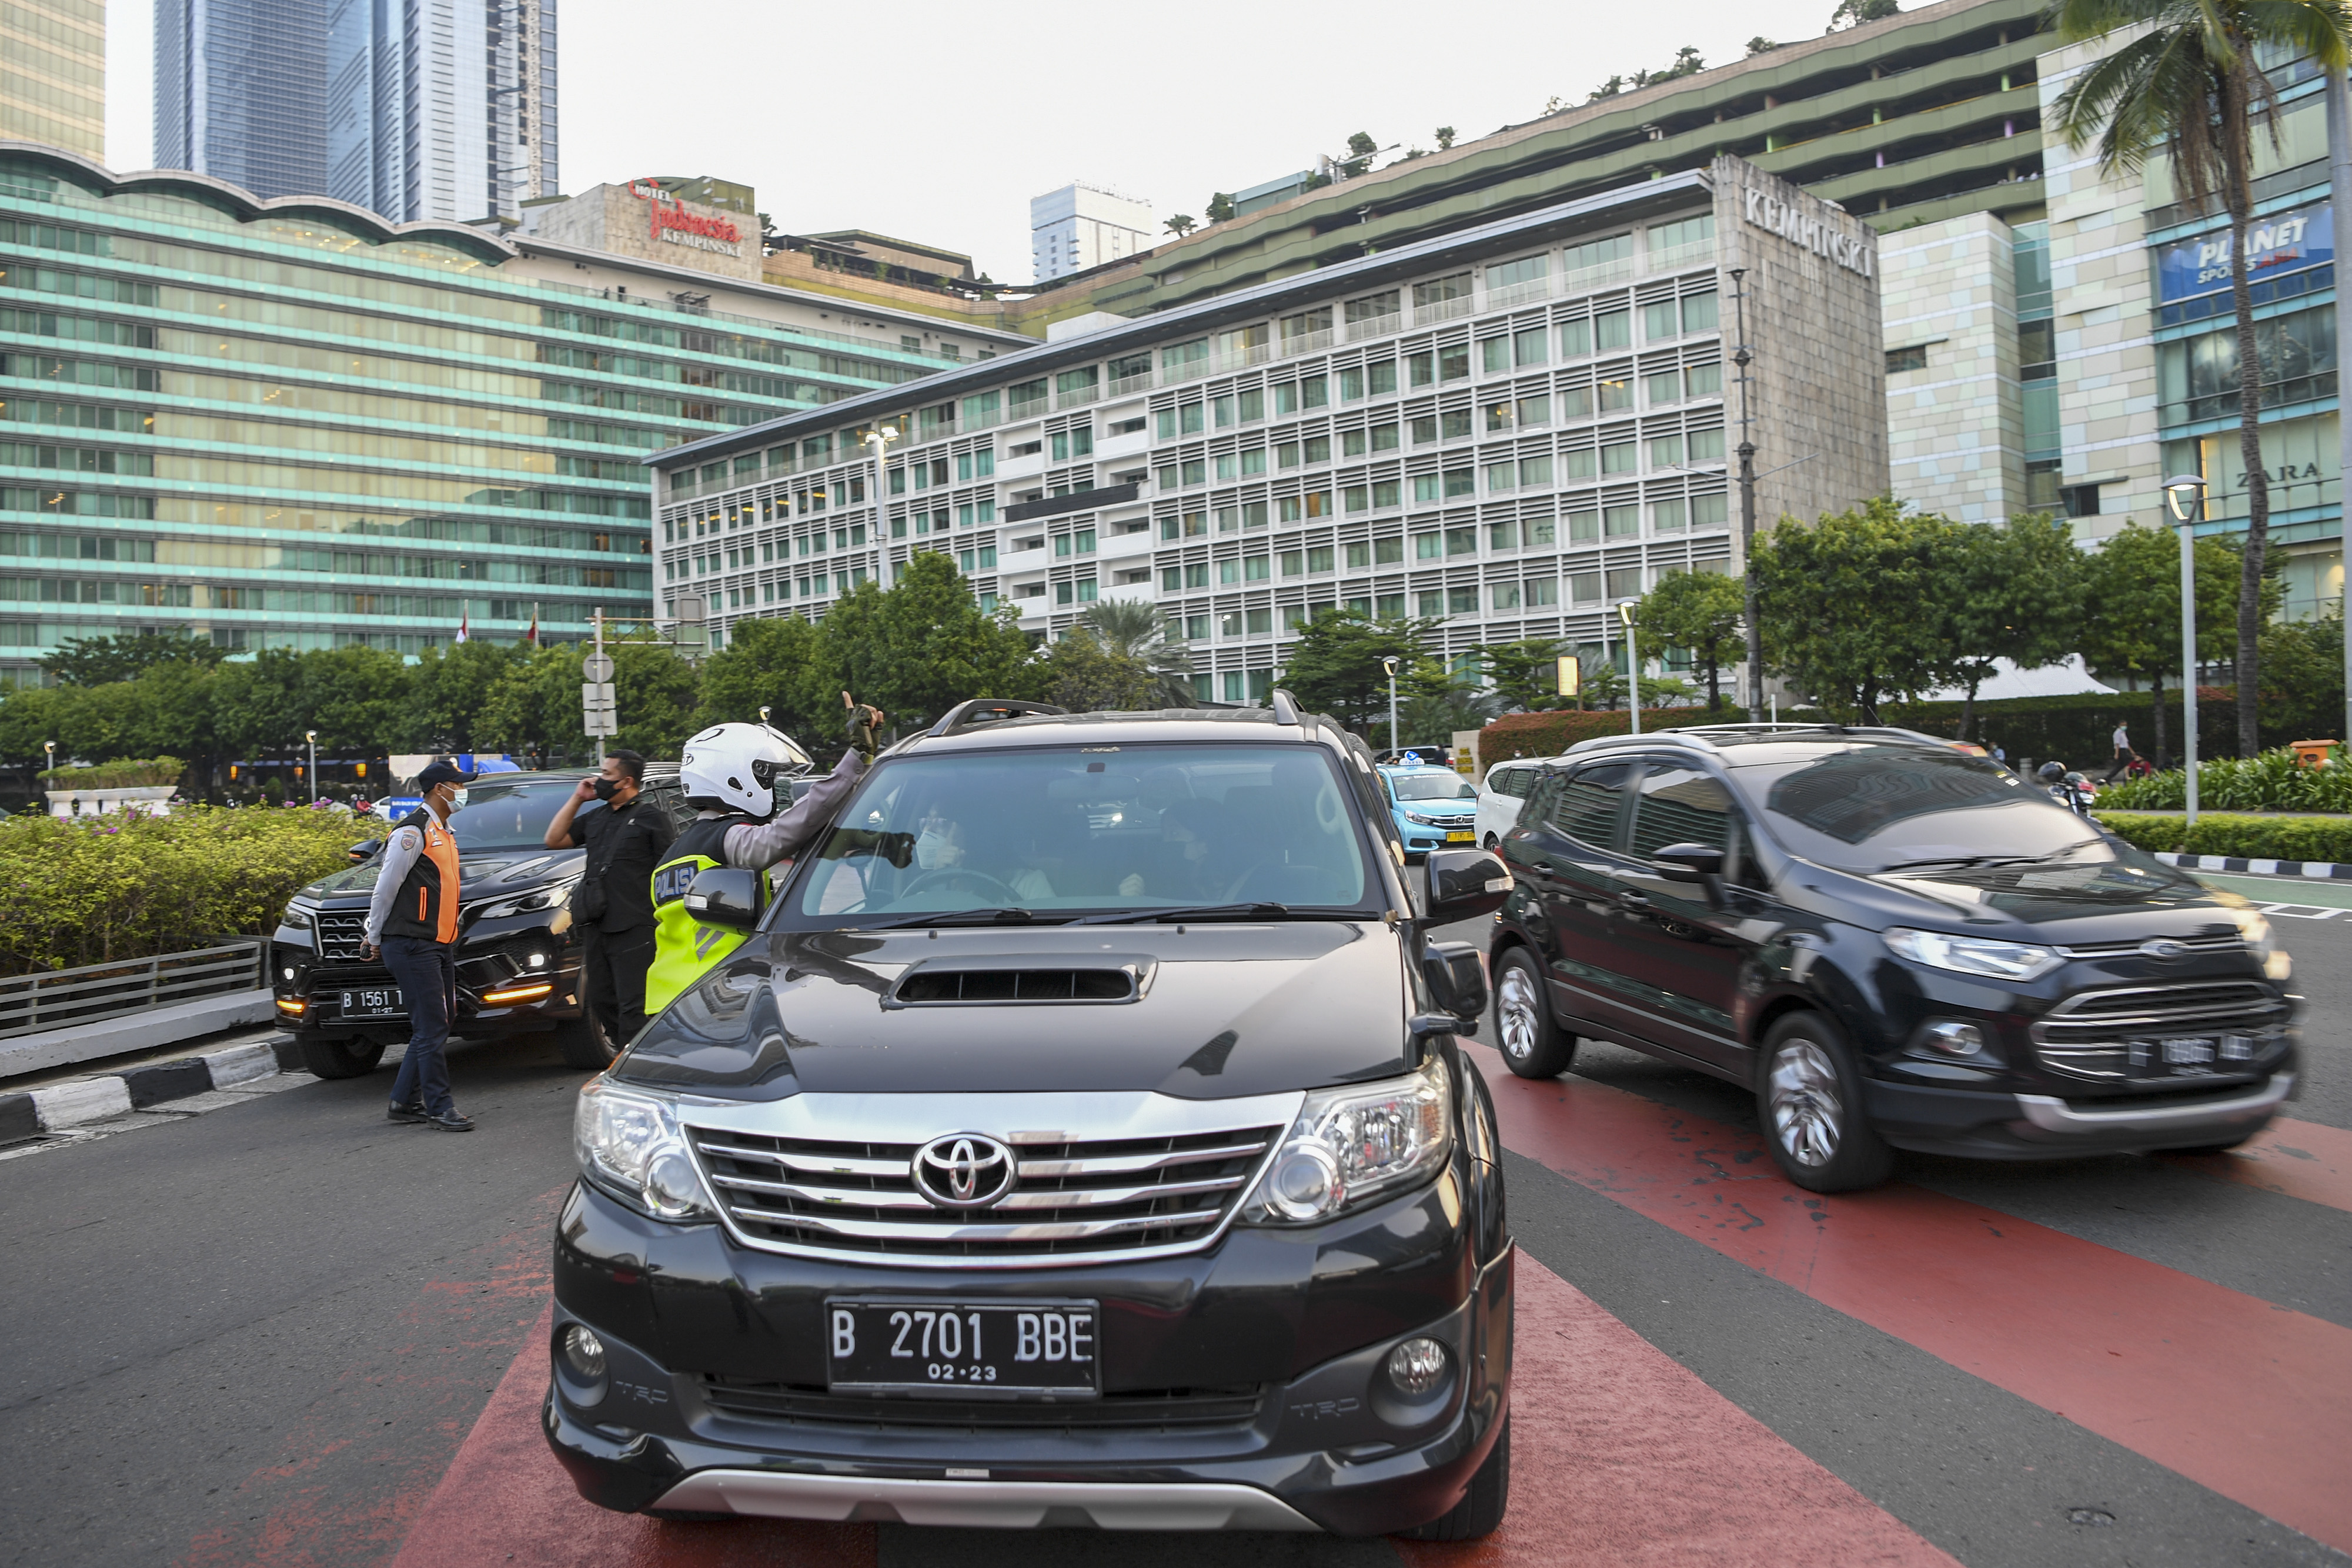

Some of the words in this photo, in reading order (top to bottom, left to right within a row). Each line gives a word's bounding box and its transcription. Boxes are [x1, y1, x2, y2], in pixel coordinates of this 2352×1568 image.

[634, 185, 672, 202] HOTEL
[662, 228, 742, 258] KEMPINSKI
[1743, 186, 1872, 279] KEMPINSKI
[2197, 258, 2256, 284] SPOS
[343, 992, 352, 1008] B
[360, 991, 389, 1007] 1561
[833, 1310, 856, 1358] B
[890, 1311, 981, 1360] 2701
[1015, 1313, 1093, 1362] BBE
[616, 1380, 668, 1404] TRD
[1291, 1397, 1359, 1420] TRD
